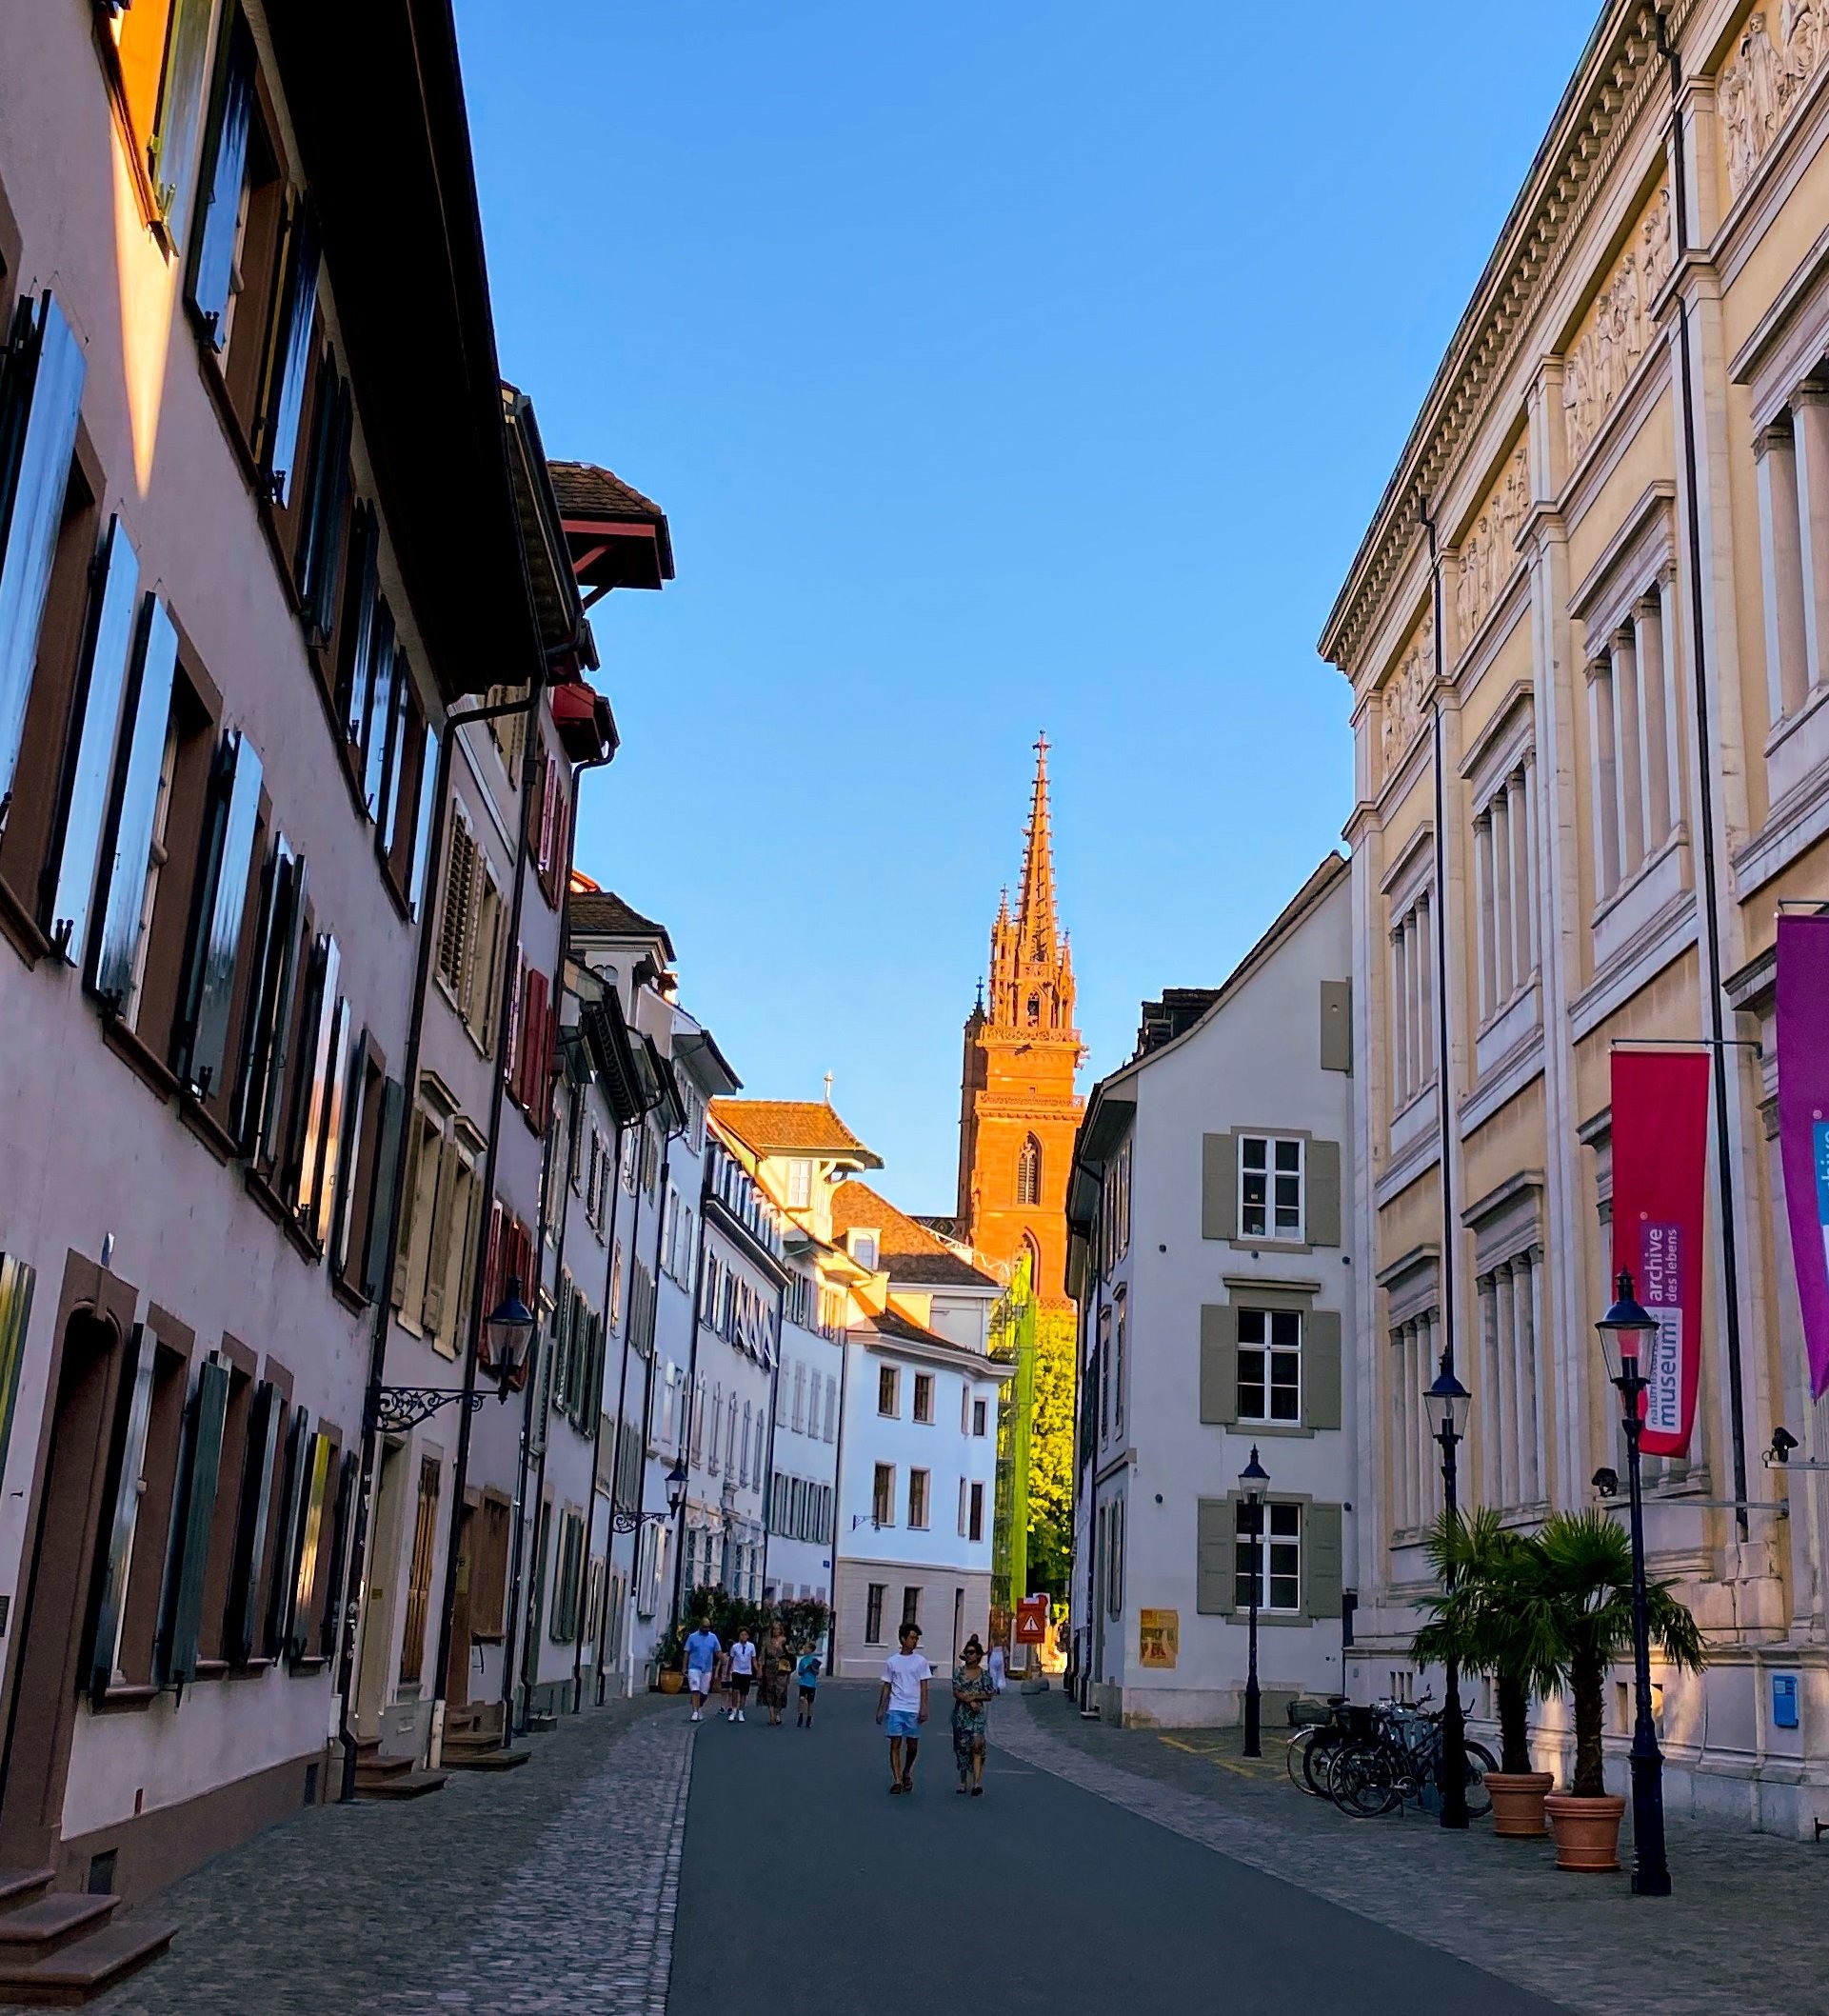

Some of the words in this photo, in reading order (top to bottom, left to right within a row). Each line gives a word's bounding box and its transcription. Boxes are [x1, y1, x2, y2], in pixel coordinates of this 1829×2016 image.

[1644, 1228, 1662, 1302] archive
[1665, 1228, 1677, 1274] lebens
[1665, 1278, 1677, 1303] des
[1661, 1322, 1676, 1426] museum
